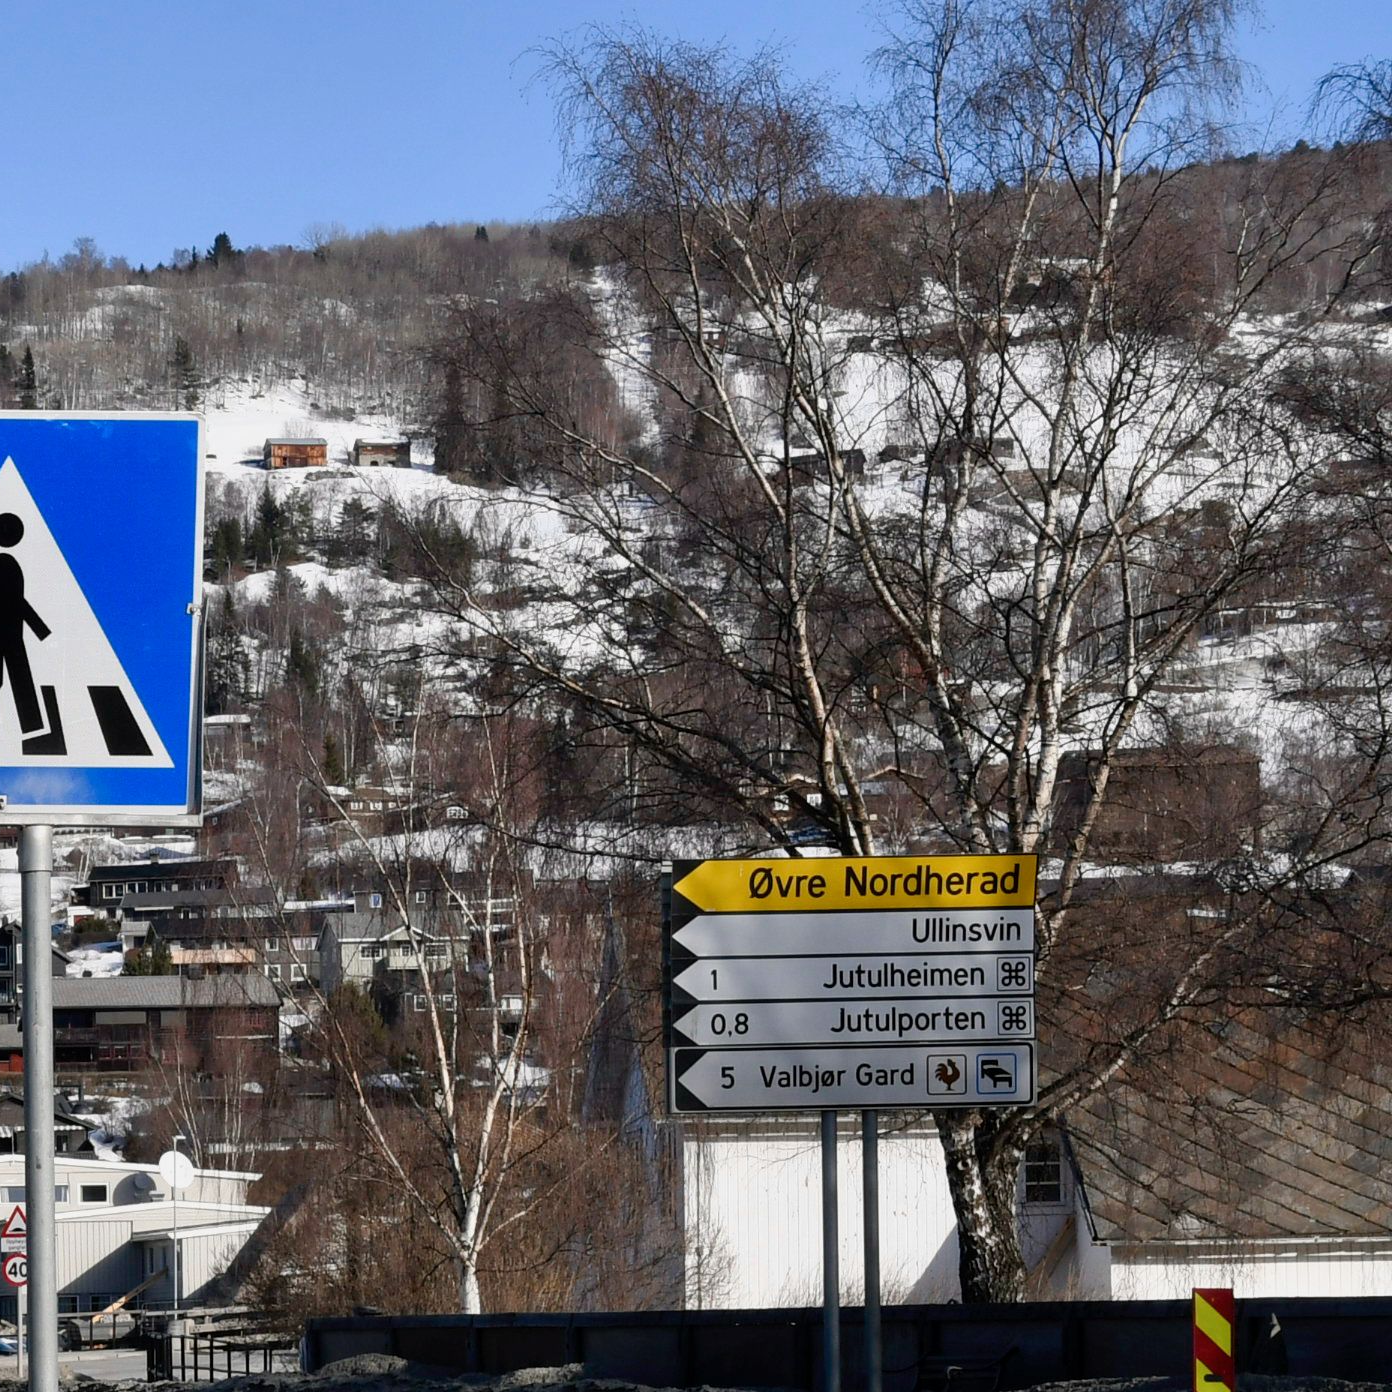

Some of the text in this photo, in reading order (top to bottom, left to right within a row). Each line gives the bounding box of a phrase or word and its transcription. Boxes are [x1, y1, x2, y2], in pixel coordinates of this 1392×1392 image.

[749, 863, 1021, 899] Øvre Nordherad
[912, 916, 1022, 943] Ullinsvin
[710, 961, 986, 991] 1 Jutulheimen
[710, 1006, 986, 1038] 0,8 Jutulporten
[720, 1063, 916, 1093] 5 Valbjør Gard
[8, 1261, 28, 1278] 40
